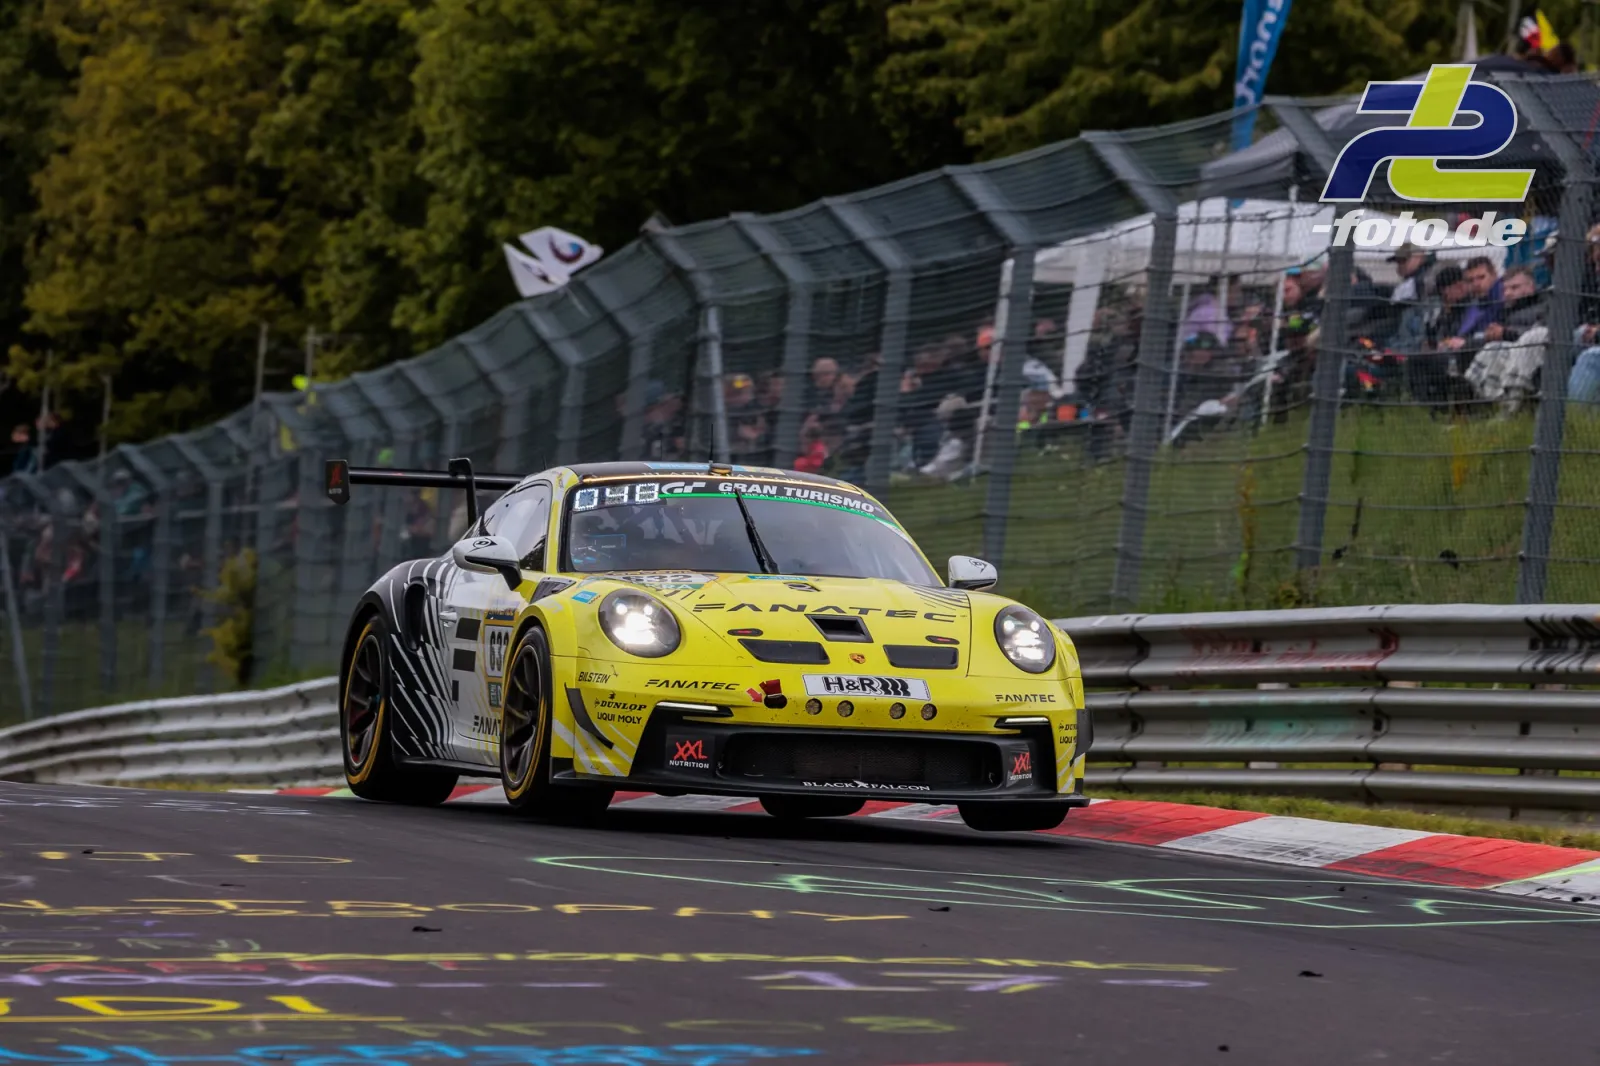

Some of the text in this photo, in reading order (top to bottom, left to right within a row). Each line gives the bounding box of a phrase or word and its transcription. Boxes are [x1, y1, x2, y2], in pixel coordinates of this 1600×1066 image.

[575, 483, 660, 509] 048
[719, 482, 875, 513] GRAN TURISMO
[693, 602, 956, 623] FANATEC
[578, 671, 611, 684] BILSTEIN
[645, 679, 740, 691] FANATEC
[822, 676, 882, 696] H&R
[599, 700, 648, 711] DUNLOP
[995, 694, 1057, 703] FANATEC
[596, 711, 643, 725] LIQUI MOLY
[673, 740, 709, 760] XXL
[669, 759, 710, 769] NUTRITION
[1011, 751, 1032, 775] XXL
[802, 781, 931, 791] BLACK FALCON
